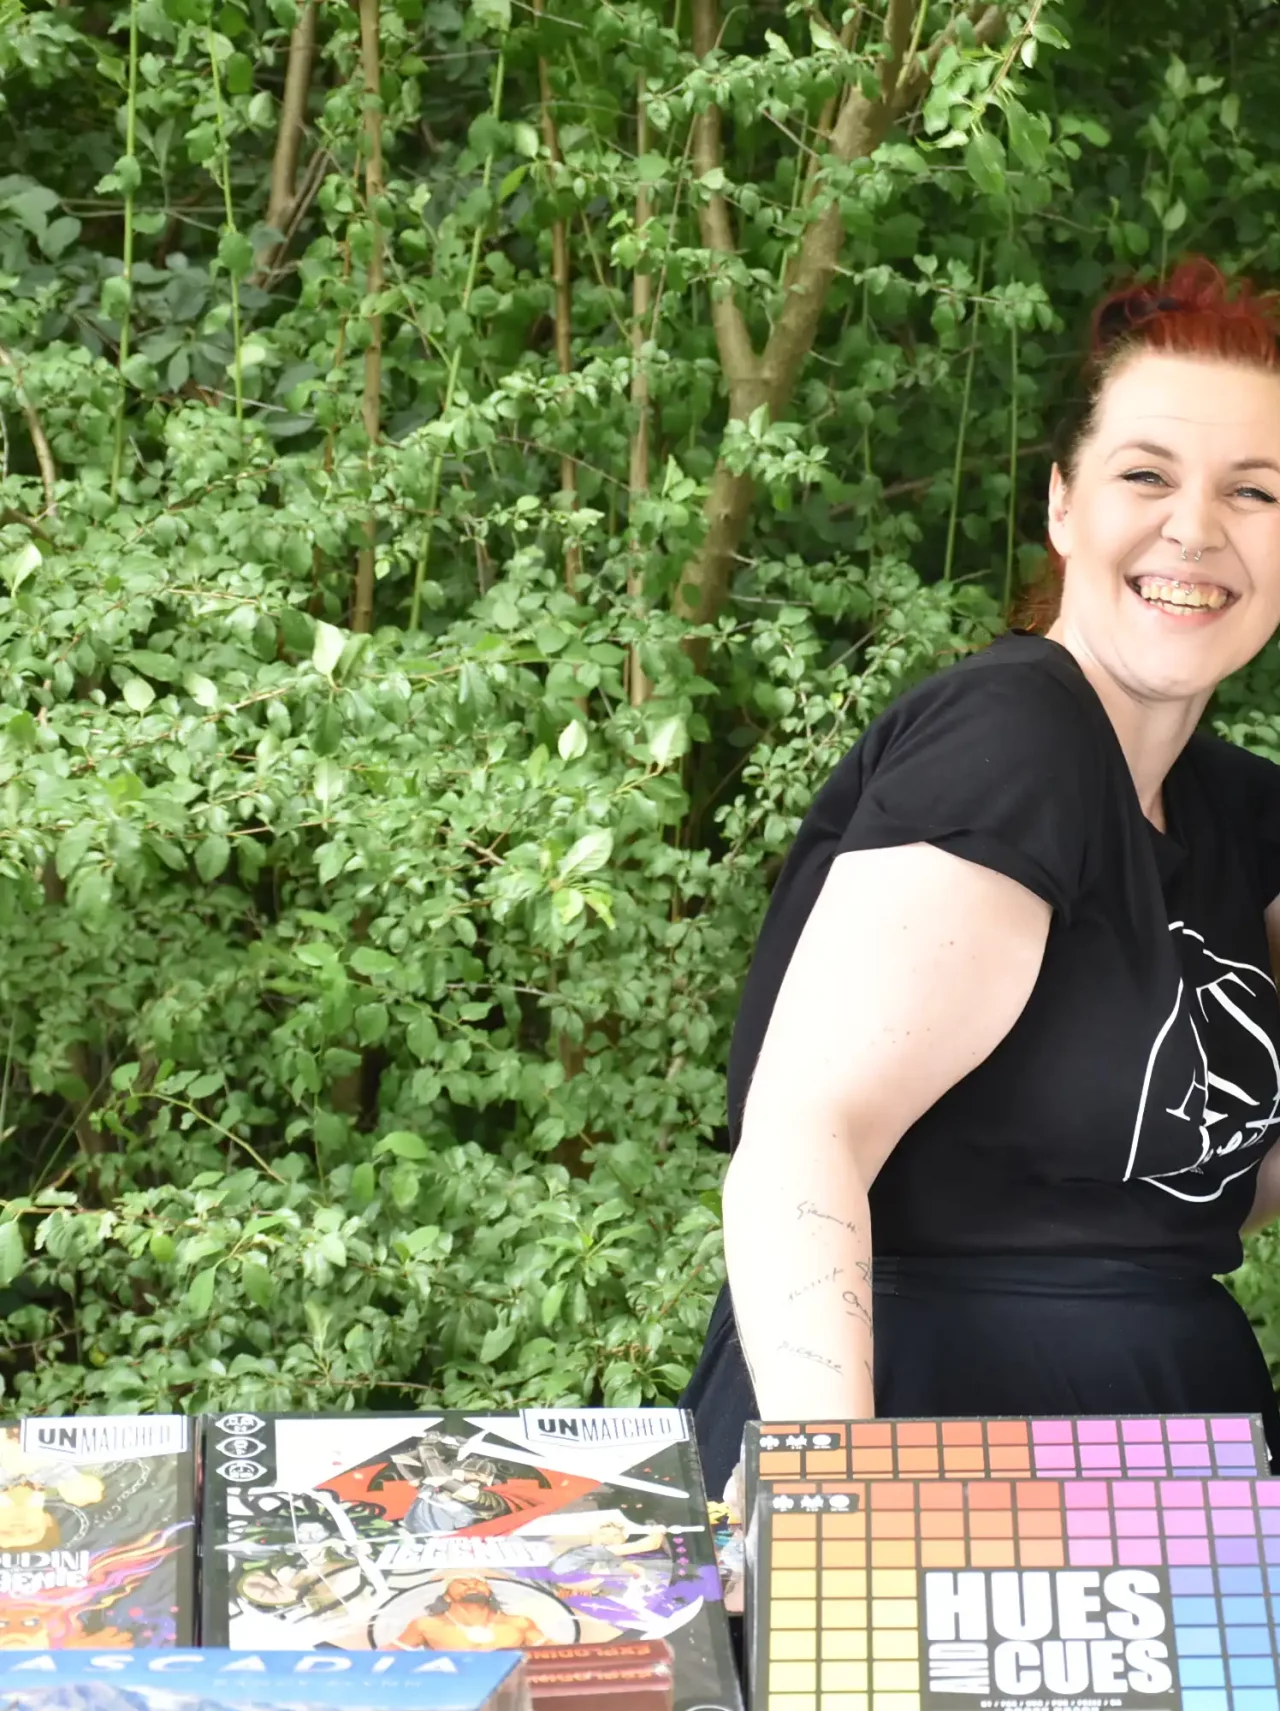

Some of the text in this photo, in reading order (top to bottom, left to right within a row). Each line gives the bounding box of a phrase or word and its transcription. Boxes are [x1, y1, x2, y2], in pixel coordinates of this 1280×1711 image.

[925, 1570, 1166, 1640] HUES
[8, 1654, 459, 1673] ASCADIA
[928, 1642, 990, 1694] AND
[993, 1639, 1173, 1695] CUES
